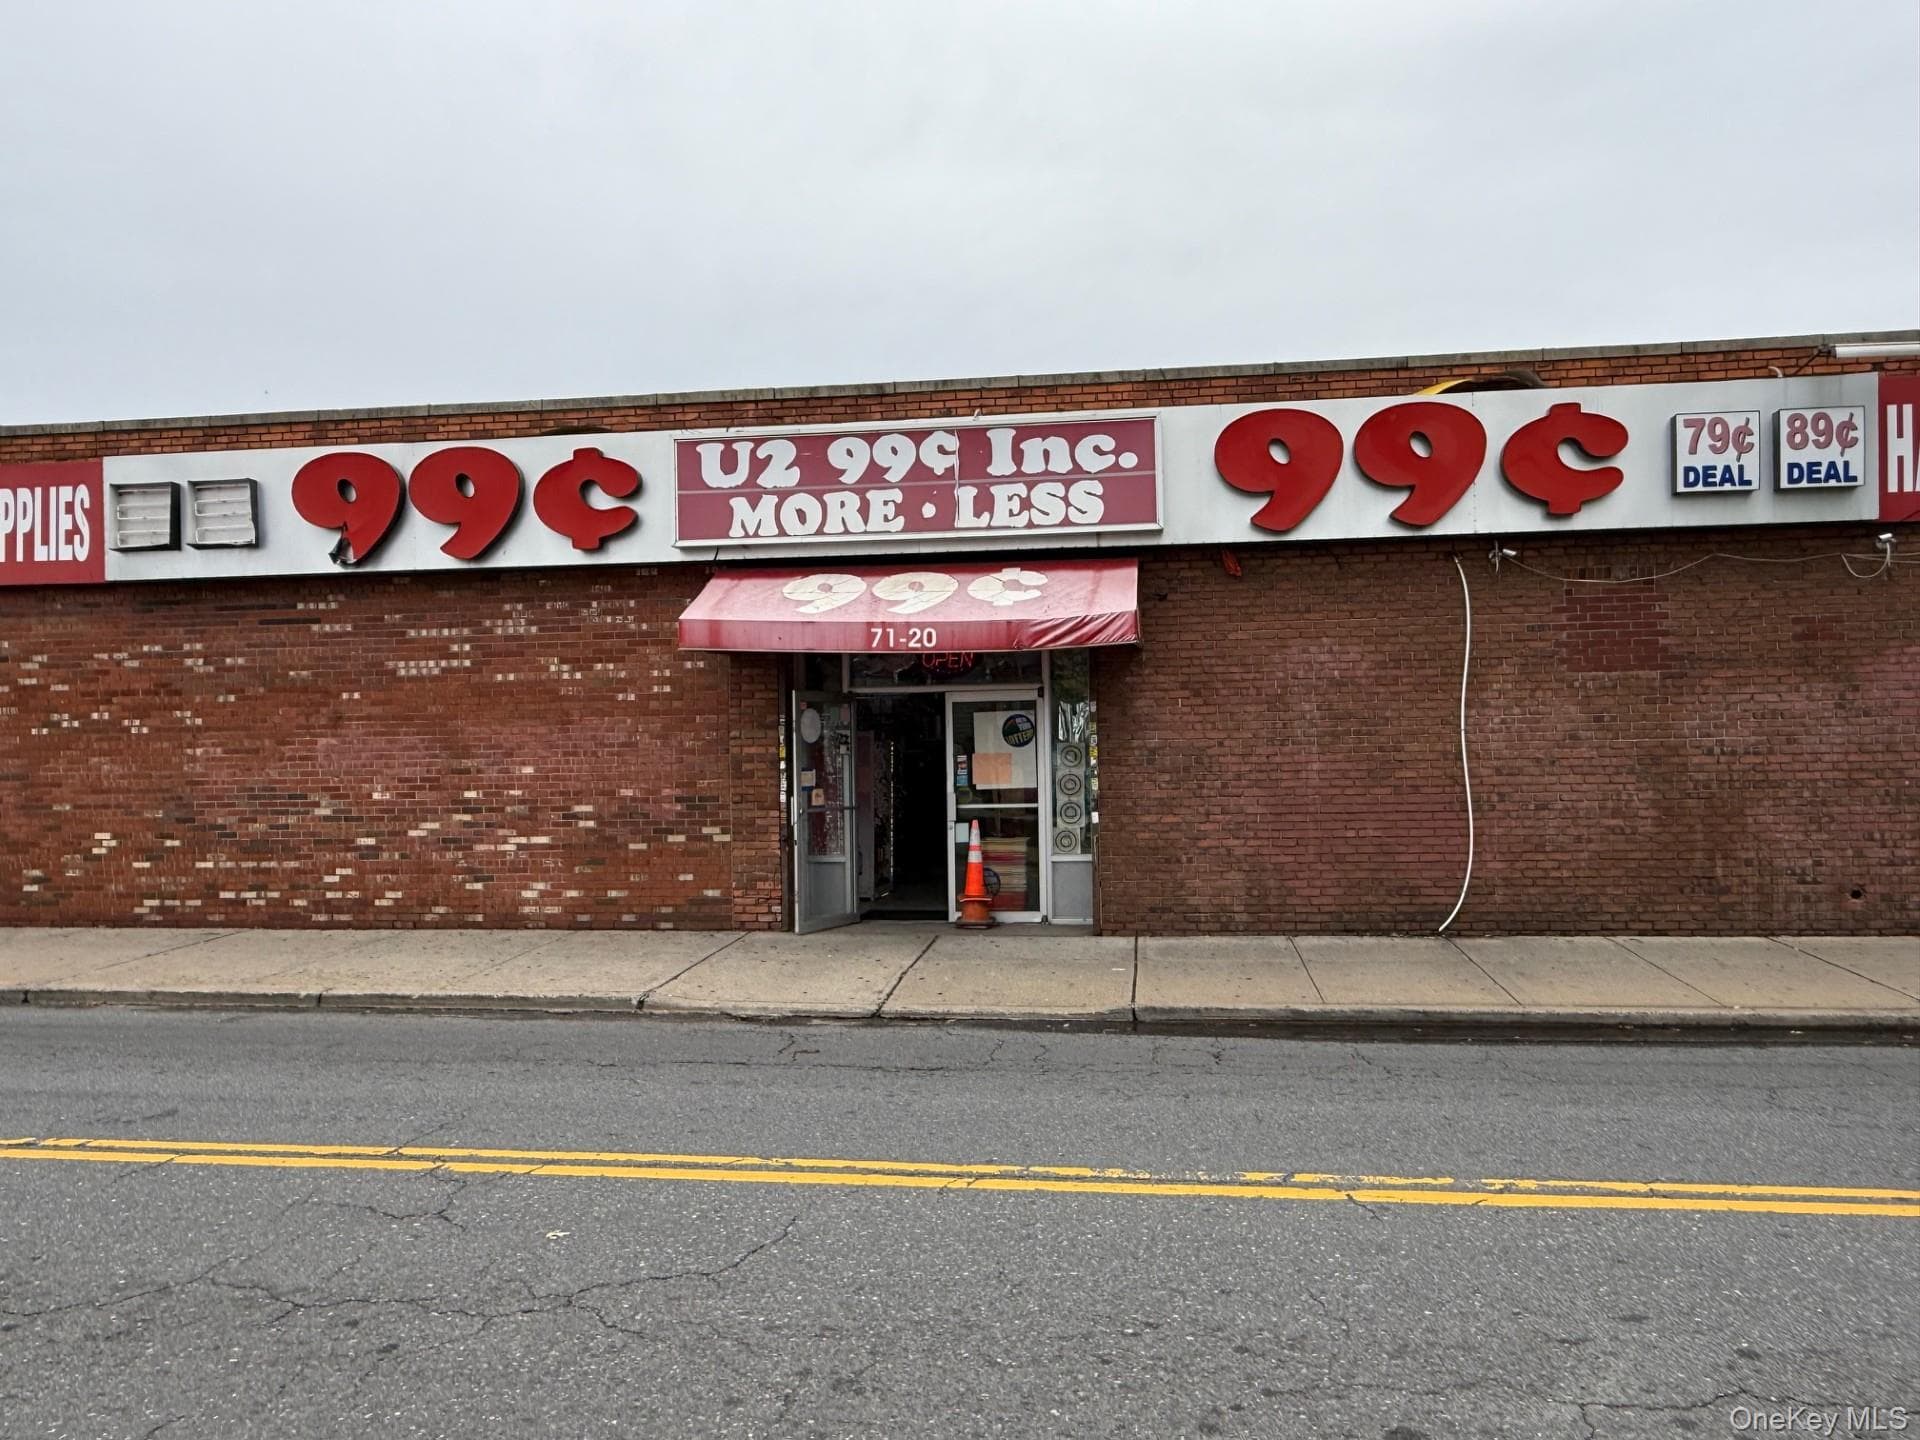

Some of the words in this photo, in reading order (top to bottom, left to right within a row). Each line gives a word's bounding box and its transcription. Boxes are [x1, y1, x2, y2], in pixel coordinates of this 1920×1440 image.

[1683, 417, 1755, 462] 79¢
[1786, 412, 1859, 457] 89¢
[1886, 403, 1920, 493] H
[696, 438, 801, 489] U2
[826, 430, 959, 486] 99¢
[986, 427, 1138, 477] Inc.
[1214, 401, 1629, 532] 99¢
[1683, 464, 1753, 488] DEAL
[1787, 460, 1858, 485] DEAL
[293, 446, 641, 565] 99¢
[727, 488, 905, 538] MORE
[954, 479, 1106, 530] LESS
[782, 567, 1049, 615] 99¢
[870, 627, 937, 648] 71-20
[922, 651, 975, 669] OPEN
